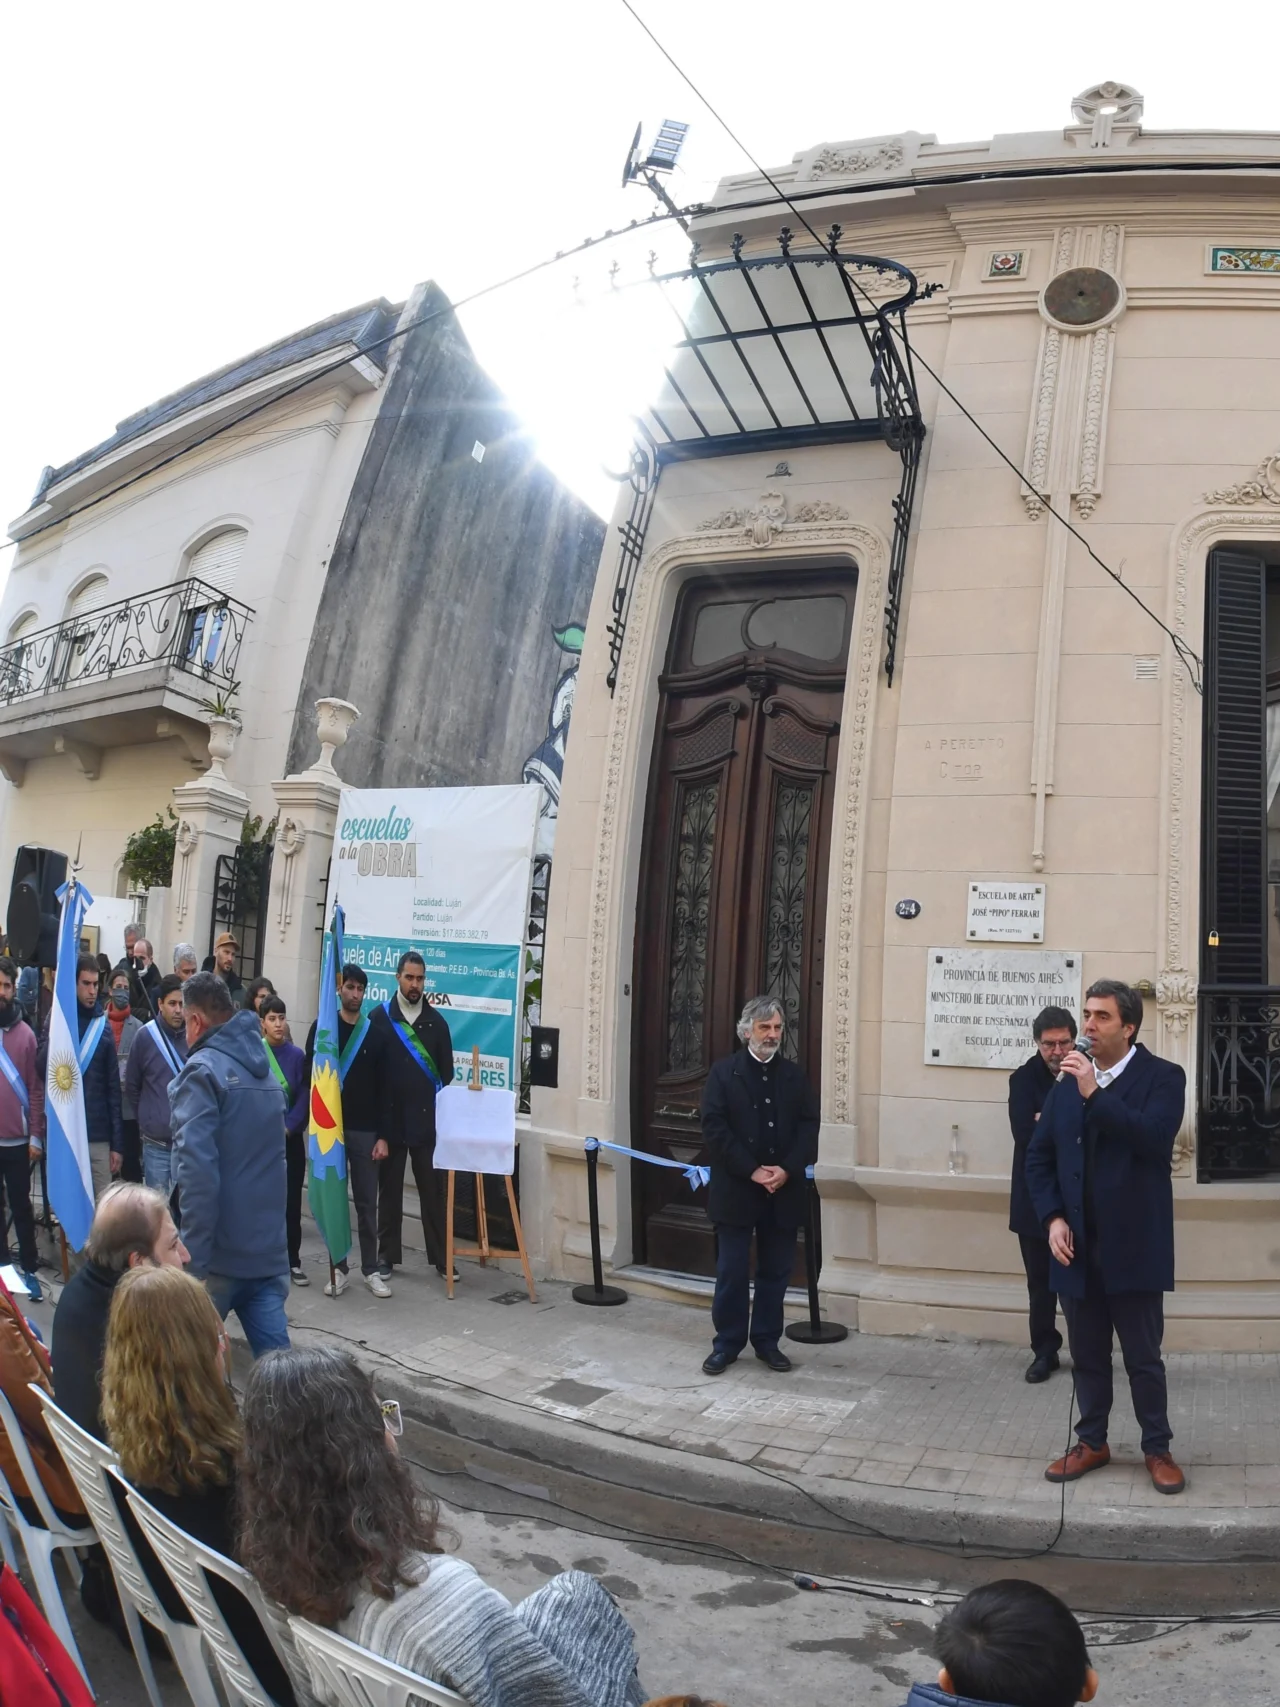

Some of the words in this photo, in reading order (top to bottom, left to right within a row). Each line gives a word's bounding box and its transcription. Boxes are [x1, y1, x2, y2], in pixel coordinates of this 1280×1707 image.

[341, 805, 414, 840] escuelas
[339, 847, 346, 859] a
[348, 840, 357, 860] la
[358, 842, 416, 877] OBRA
[978, 891, 1007, 900] ESCUELA
[1008, 892, 1017, 901] DE
[1018, 892, 1036, 901] ARTE
[413, 897, 443, 907] Localidad:
[445, 898, 461, 909] Luján
[412, 912, 435, 922] Partido:
[437, 913, 453, 924] Luján
[972, 906, 987, 917] JOSÉ
[1011, 909, 1040, 918] FERRARI
[411, 927, 440, 937] Inversión:
[368, 945, 382, 966] de
[384, 947, 404, 968] Art
[426, 947, 435, 957] 120
[473, 966, 497, 977] Provincia
[498, 969, 506, 978] Bs.
[507, 970, 516, 979] As.
[943, 969, 985, 982] PROVINCIA
[988, 971, 999, 982] DE
[1002, 971, 1036, 983] BUENOS
[1038, 971, 1064, 984] AIRES
[425, 992, 452, 1006] ASA
[931, 991, 972, 1004] MINISTERIO
[973, 993, 984, 1004] DE
[985, 993, 1028, 1006] EDUCACION
[1031, 995, 1038, 1006] Y
[1038, 995, 1075, 1008] CULTURA
[934, 1014, 972, 1025] DIRECCION
[973, 1015, 983, 1025] DE
[985, 1015, 1029, 1027] ENSEÑANZA
[965, 1036, 1000, 1046] ESCUELA
[1002, 1037, 1013, 1047] DE
[1015, 1038, 1037, 1048] ARTE
[461, 1058, 494, 1068] PRONCIA
[495, 1062, 504, 1070] DE
[466, 1068, 505, 1087] ARES
